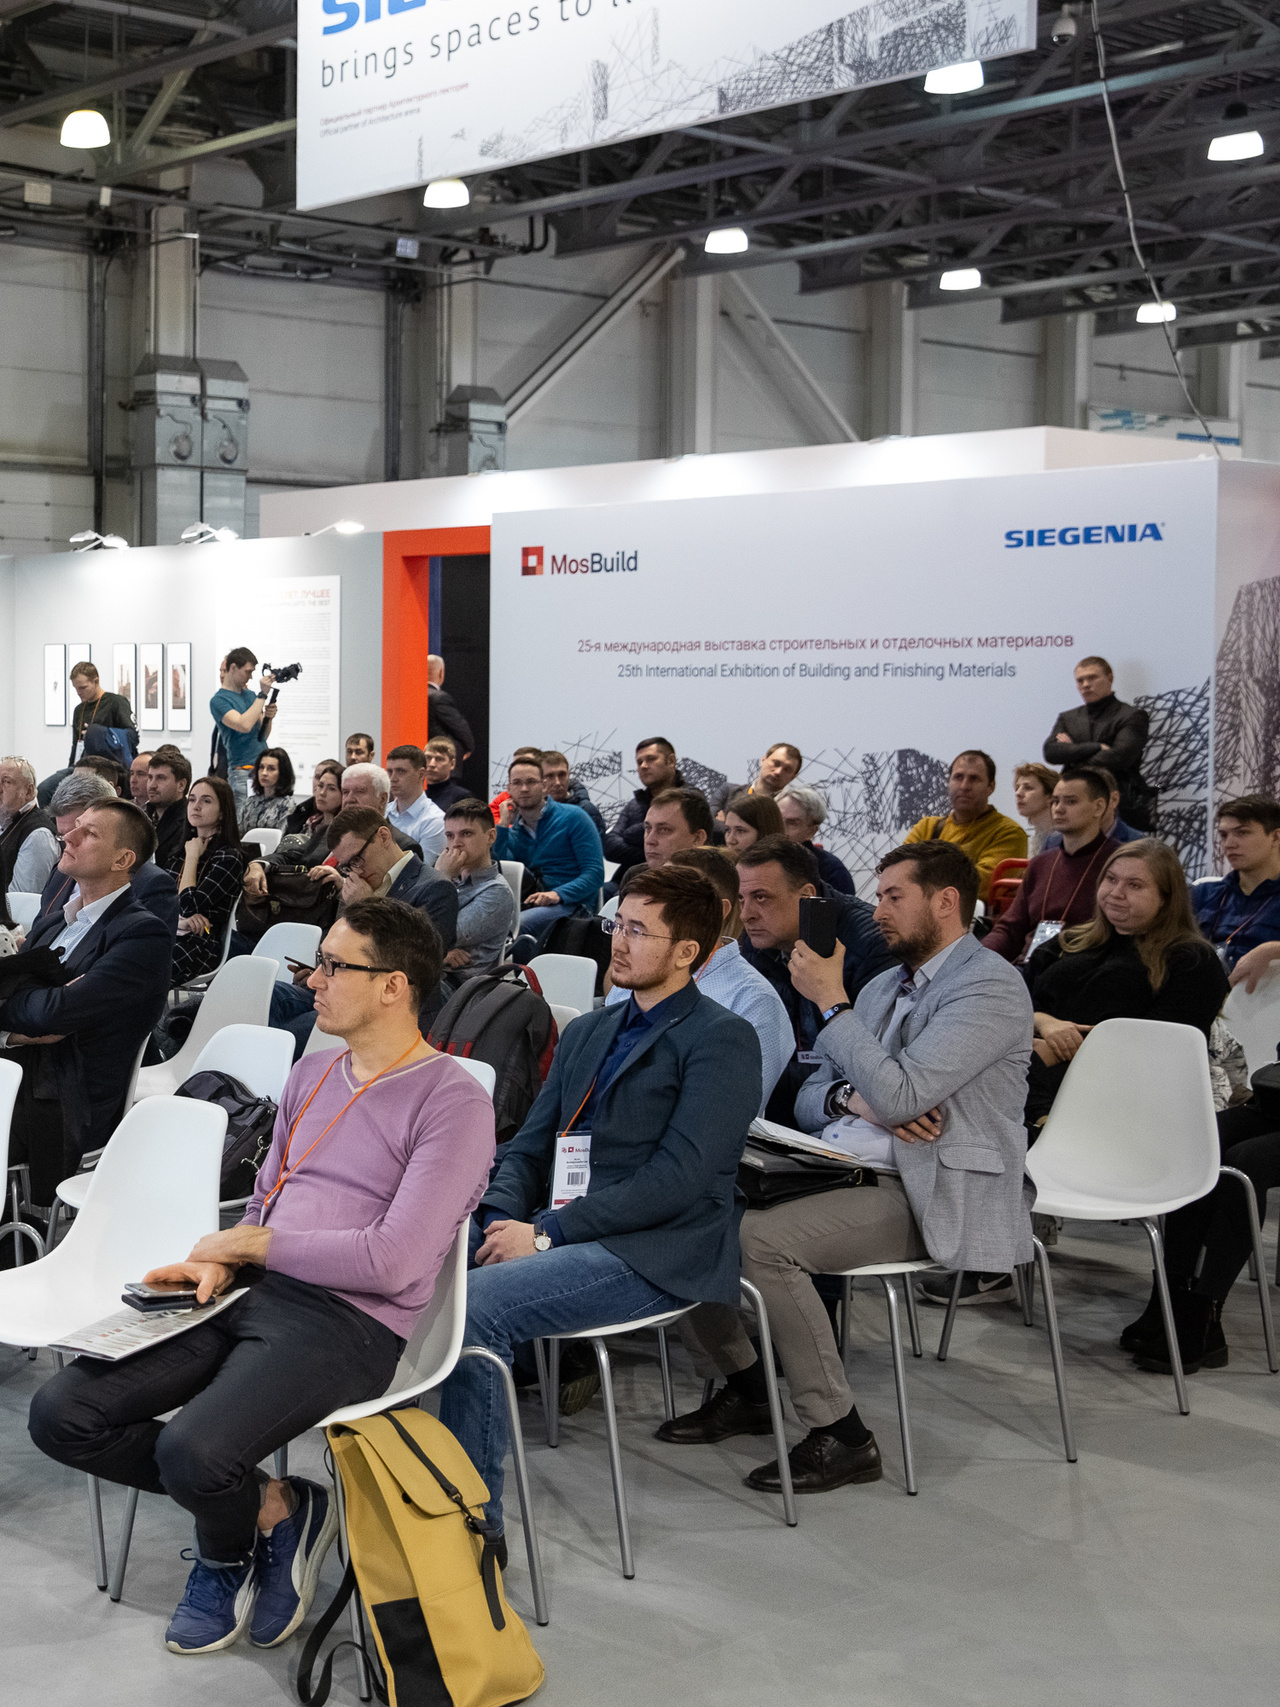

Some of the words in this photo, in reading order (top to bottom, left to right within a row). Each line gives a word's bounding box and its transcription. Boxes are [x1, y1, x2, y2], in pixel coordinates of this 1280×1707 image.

[321, 42, 414, 88] brings
[430, 6, 541, 61] spaces
[558, 0, 592, 21] to
[1004, 523, 1163, 548] SIEGENIA
[551, 550, 638, 575] MosBuild
[577, 639, 601, 653] 25-я
[604, 639, 701, 655] международная
[705, 639, 766, 651] выставка
[770, 637, 866, 653] строительных
[870, 638, 878, 649] и
[882, 636, 972, 651] отделочных
[977, 634, 1074, 651] материалов
[618, 663, 643, 677] 25th
[645, 663, 717, 677] International
[720, 662, 779, 677] Exhibition
[782, 662, 796, 677] of
[799, 662, 851, 681] Building
[854, 662, 879, 677] and
[883, 662, 944, 681] Finishing
[949, 661, 1017, 678] Materials
